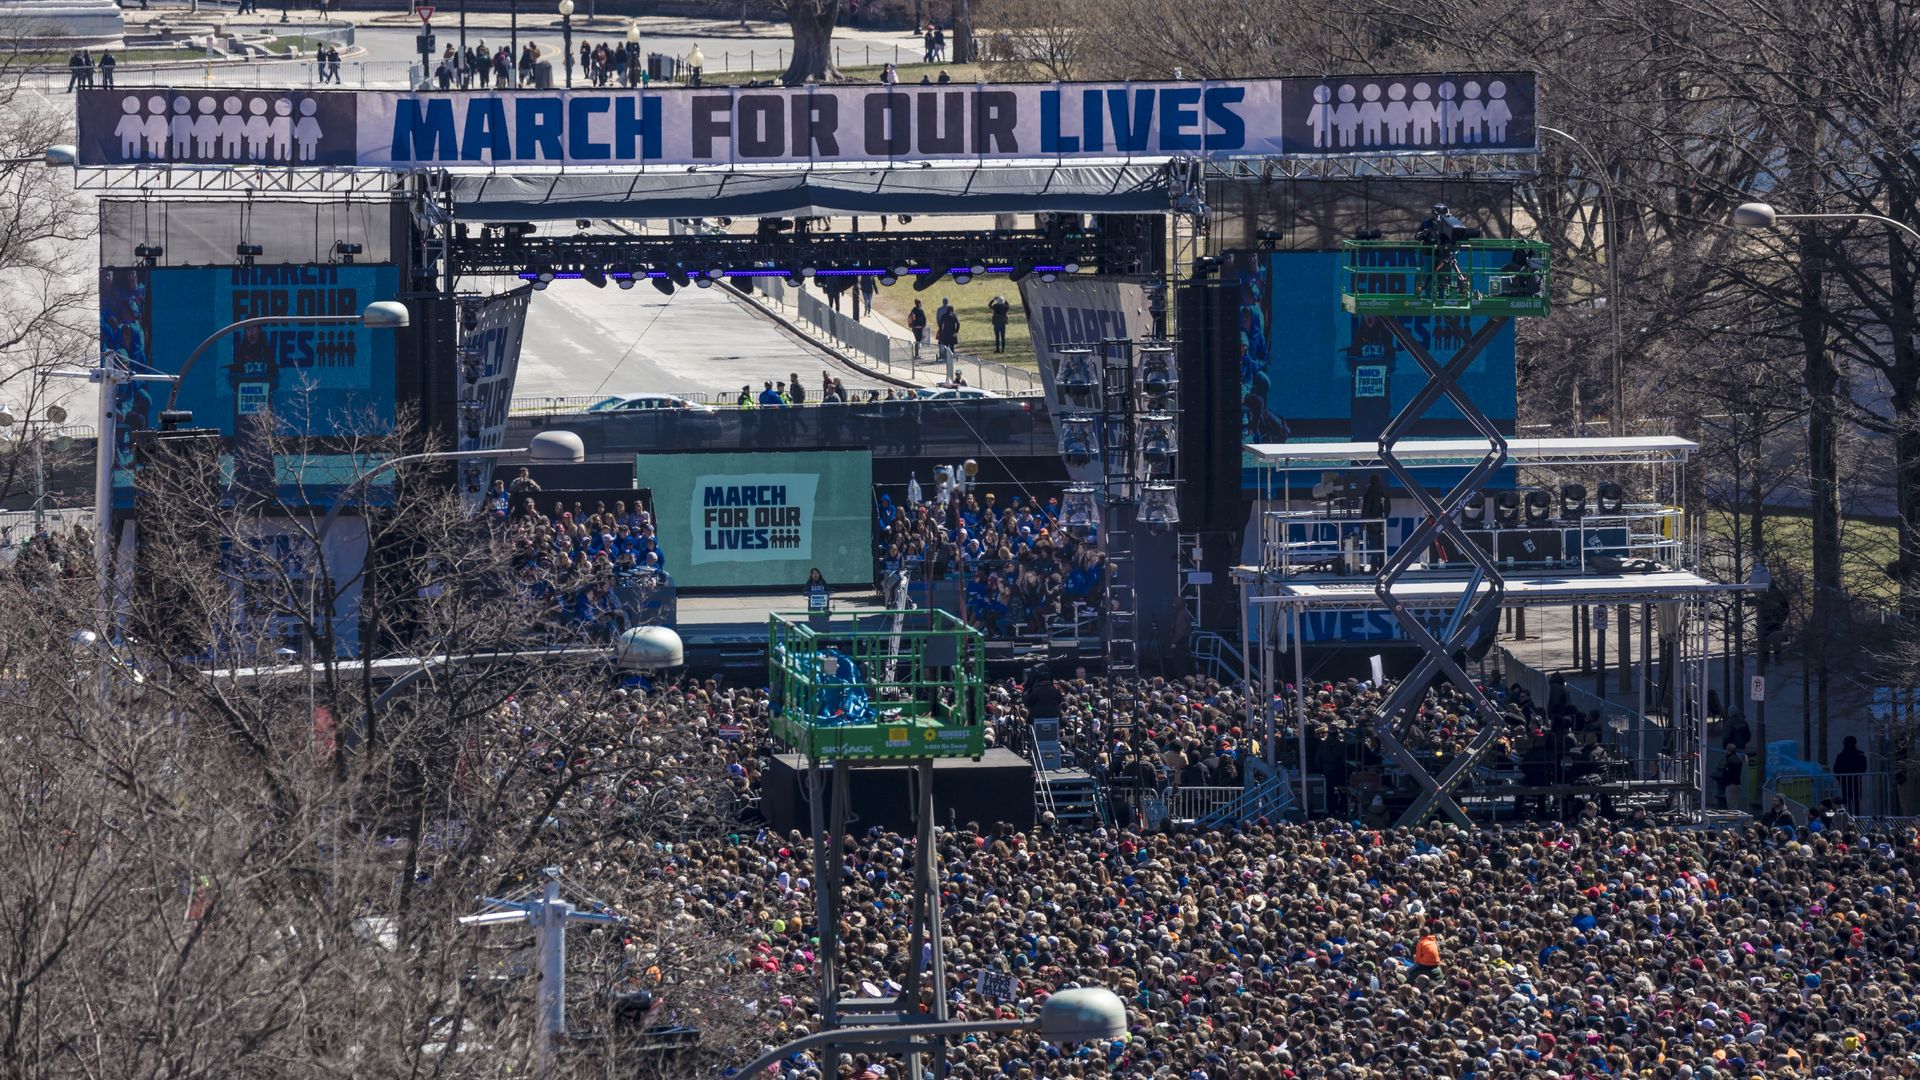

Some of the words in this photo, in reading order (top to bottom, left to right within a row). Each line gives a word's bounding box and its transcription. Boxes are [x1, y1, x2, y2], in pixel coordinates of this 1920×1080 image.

[391, 96, 662, 161] MARCH
[692, 93, 840, 158] FOR
[864, 91, 1019, 155] OUR
[1040, 87, 1245, 153] LIVES
[297, 288, 357, 326] OUR
[704, 485, 786, 506] MARCH
[705, 507, 749, 528] FOR
[755, 507, 801, 527] OUR
[705, 528, 768, 550] LIVES
[1287, 610, 1394, 640] IVES
